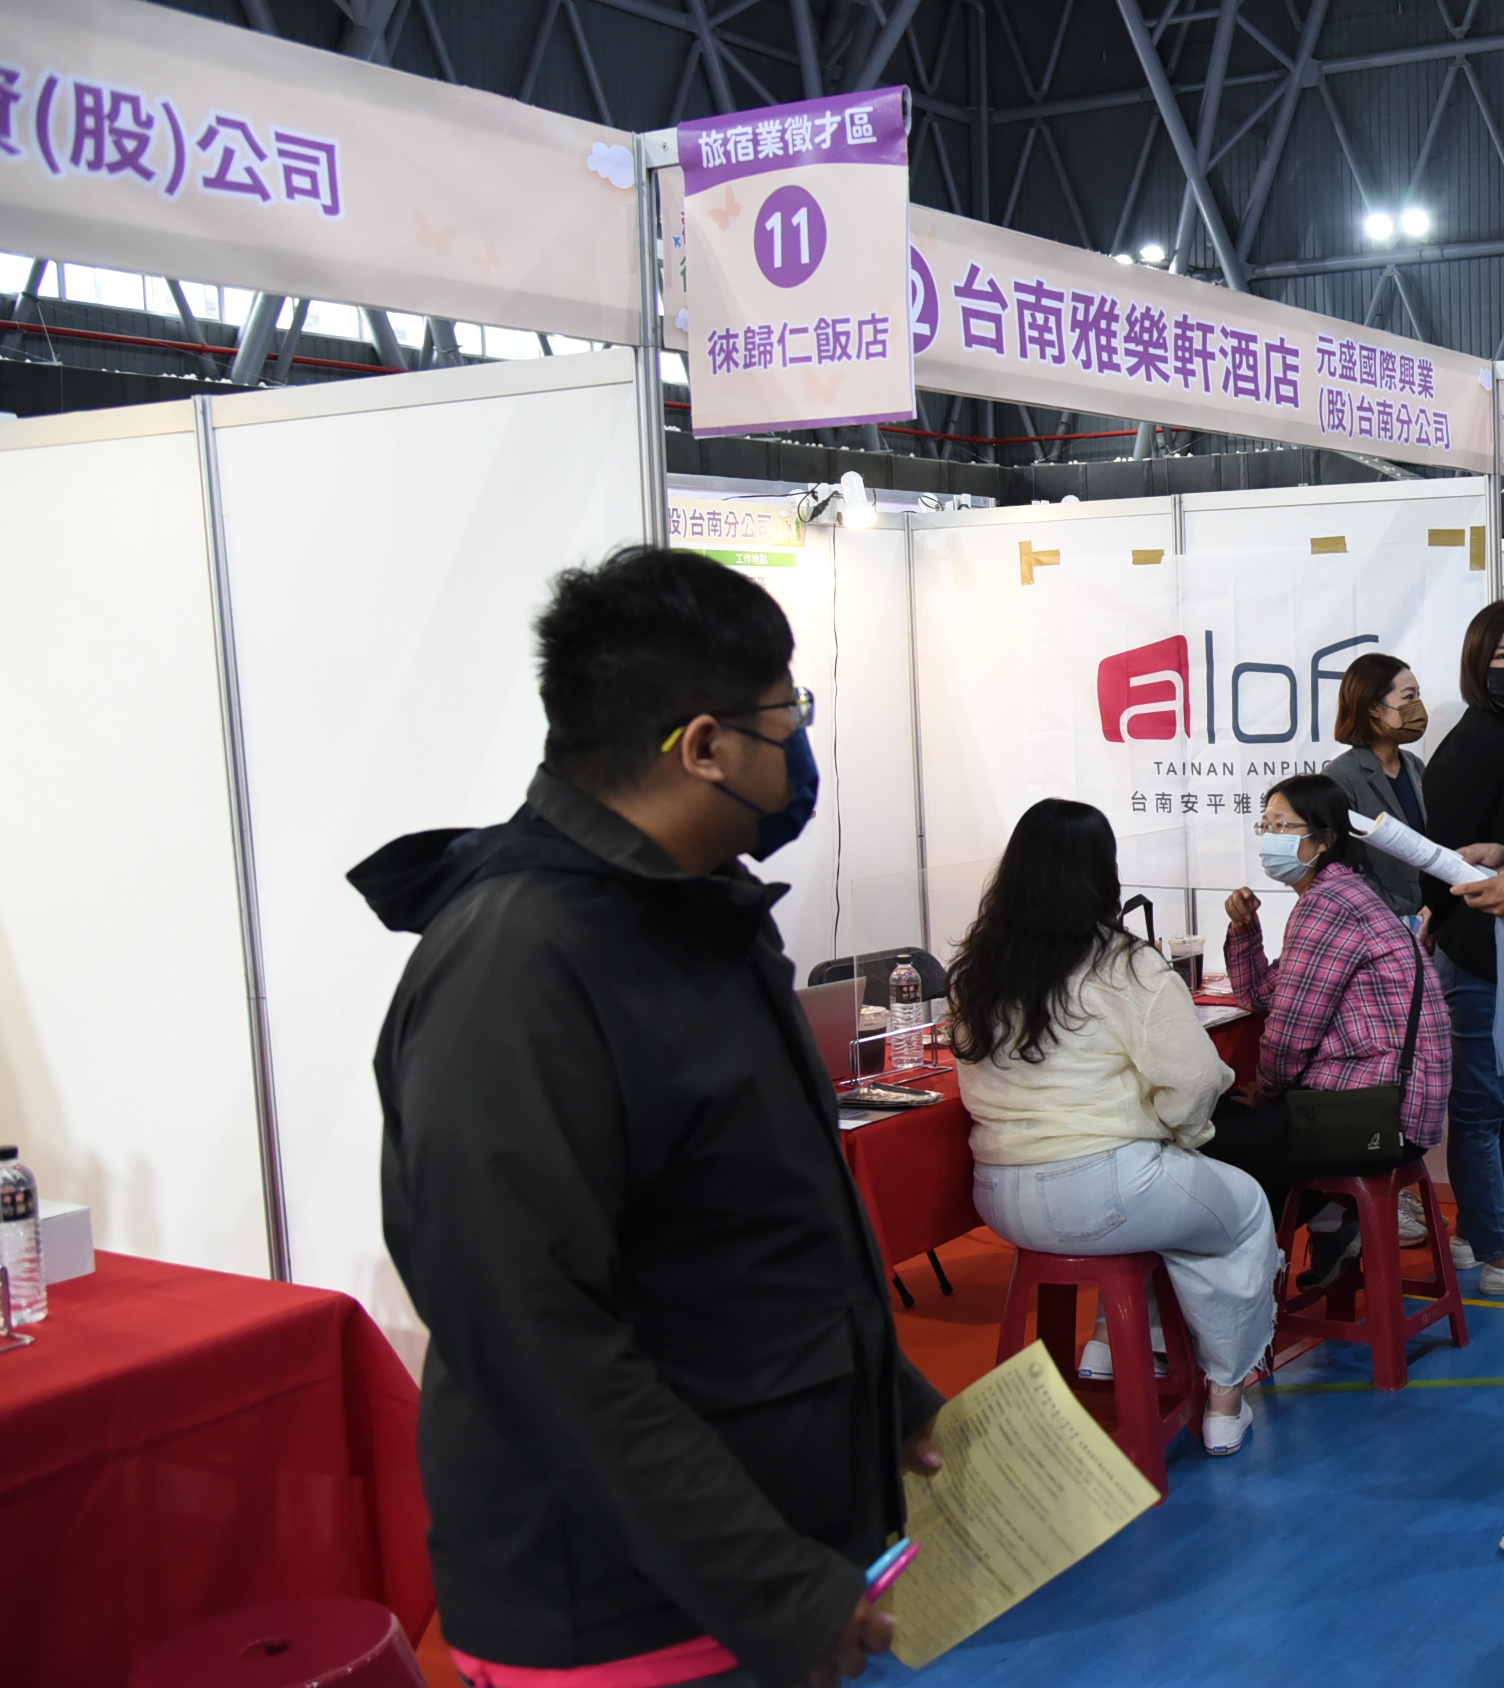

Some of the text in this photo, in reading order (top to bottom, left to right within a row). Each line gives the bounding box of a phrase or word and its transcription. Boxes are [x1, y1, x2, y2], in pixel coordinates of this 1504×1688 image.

[698, 106, 878, 169] 旅宿業徵才區
[765, 206, 811, 268] 11
[707, 312, 890, 375] 徠歸仁飯店
[952, 260, 1301, 411] 台南雅樂軒酒店
[1316, 335, 1434, 399] 元盛國際興業
[1319, 386, 1451, 450] (股)台南分公司
[1153, 761, 1234, 777] TAINAN
